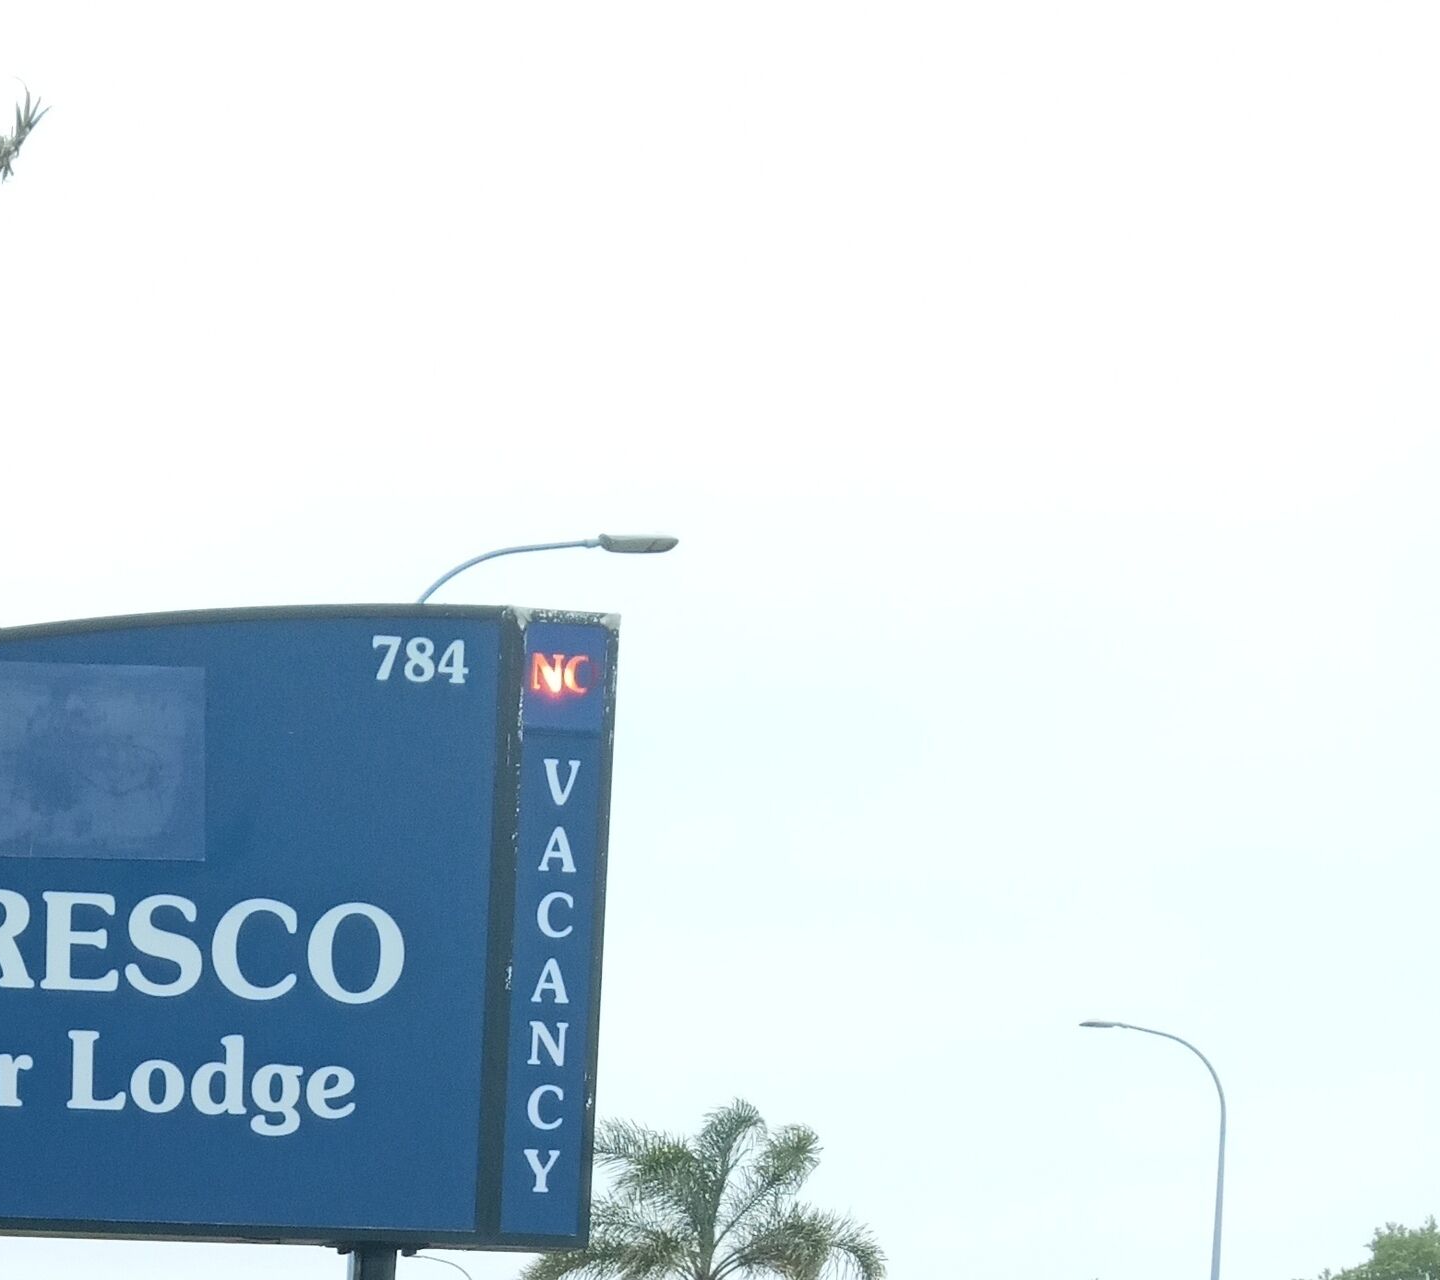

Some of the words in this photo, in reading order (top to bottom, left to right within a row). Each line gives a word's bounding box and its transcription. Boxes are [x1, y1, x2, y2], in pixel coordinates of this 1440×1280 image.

[372, 636, 468, 684] 784
[523, 758, 580, 1193] VACANCY
[68, 1030, 356, 1136] Lodge
